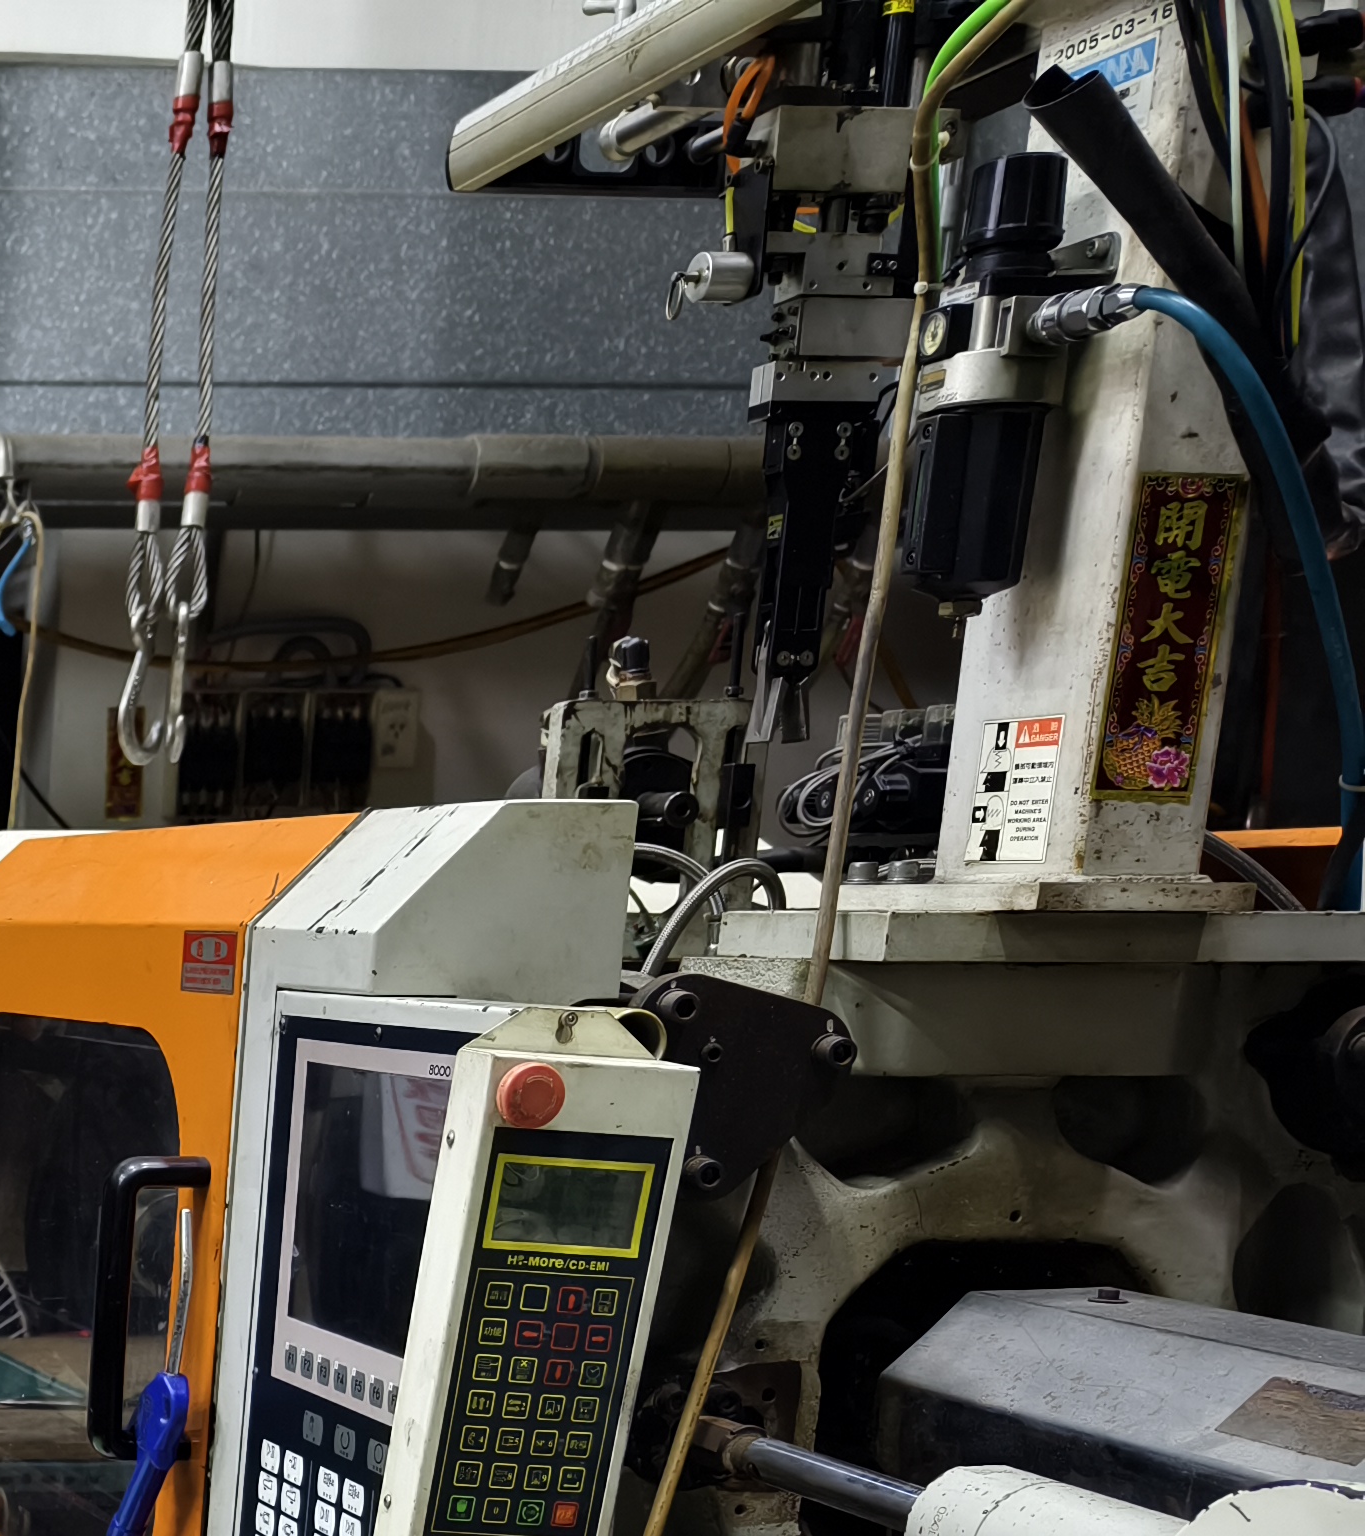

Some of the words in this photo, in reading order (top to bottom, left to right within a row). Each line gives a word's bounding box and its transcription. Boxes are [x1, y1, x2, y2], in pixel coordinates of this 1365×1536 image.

[1054, 2, 1173, 63] 2005-03-16
[1136, 499, 1209, 692] 開電大吉
[1030, 733, 1059, 743] DANGER
[288, 1352, 295, 1364] F1
[303, 1358, 310, 1372] F2
[320, 1365, 327, 1378] F3
[336, 1372, 344, 1385] F4
[354, 1379, 362, 1393] F5
[372, 1386, 380, 1400] F6
